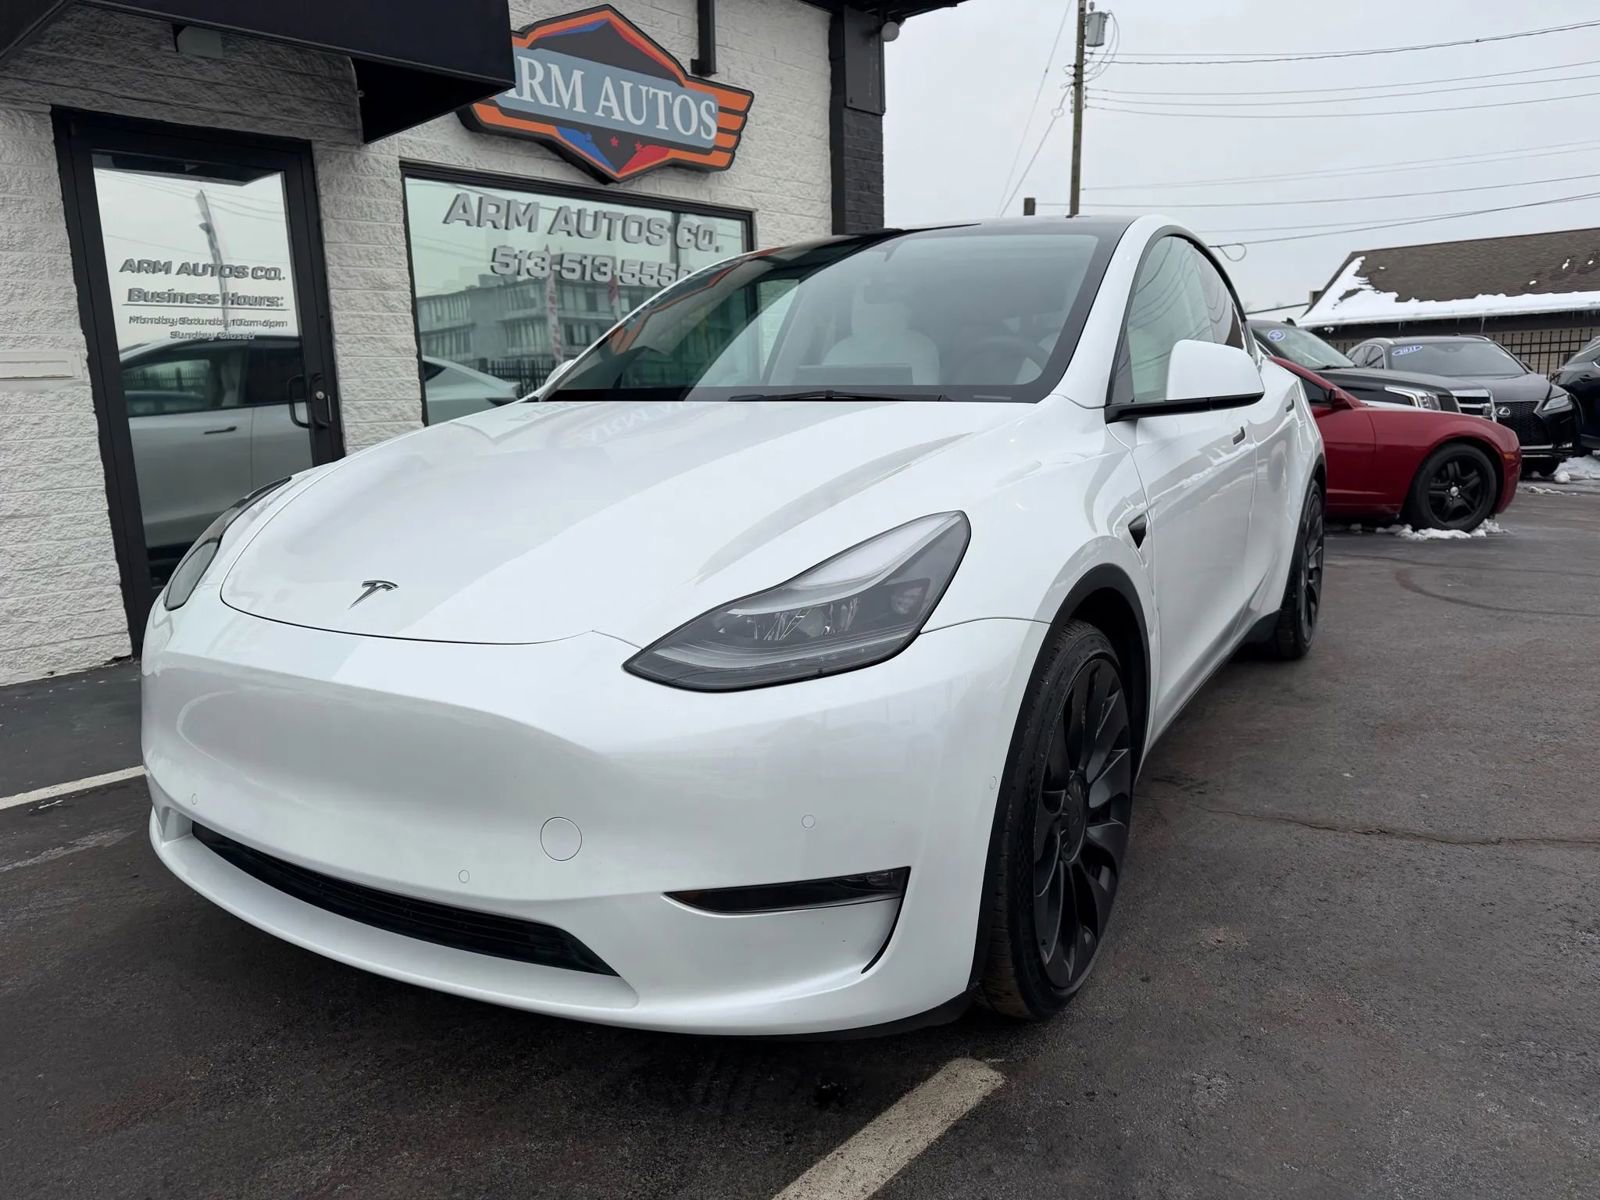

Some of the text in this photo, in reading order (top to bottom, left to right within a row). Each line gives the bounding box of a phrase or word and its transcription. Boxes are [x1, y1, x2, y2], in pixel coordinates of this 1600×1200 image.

[504, 55, 718, 141] RM AUTOS
[443, 192, 724, 253] ARM AUTOS CO.
[119, 258, 286, 281] ARM AUTOS CO.
[127, 287, 219, 305] Business
[170, 331, 215, 341] Sunday
